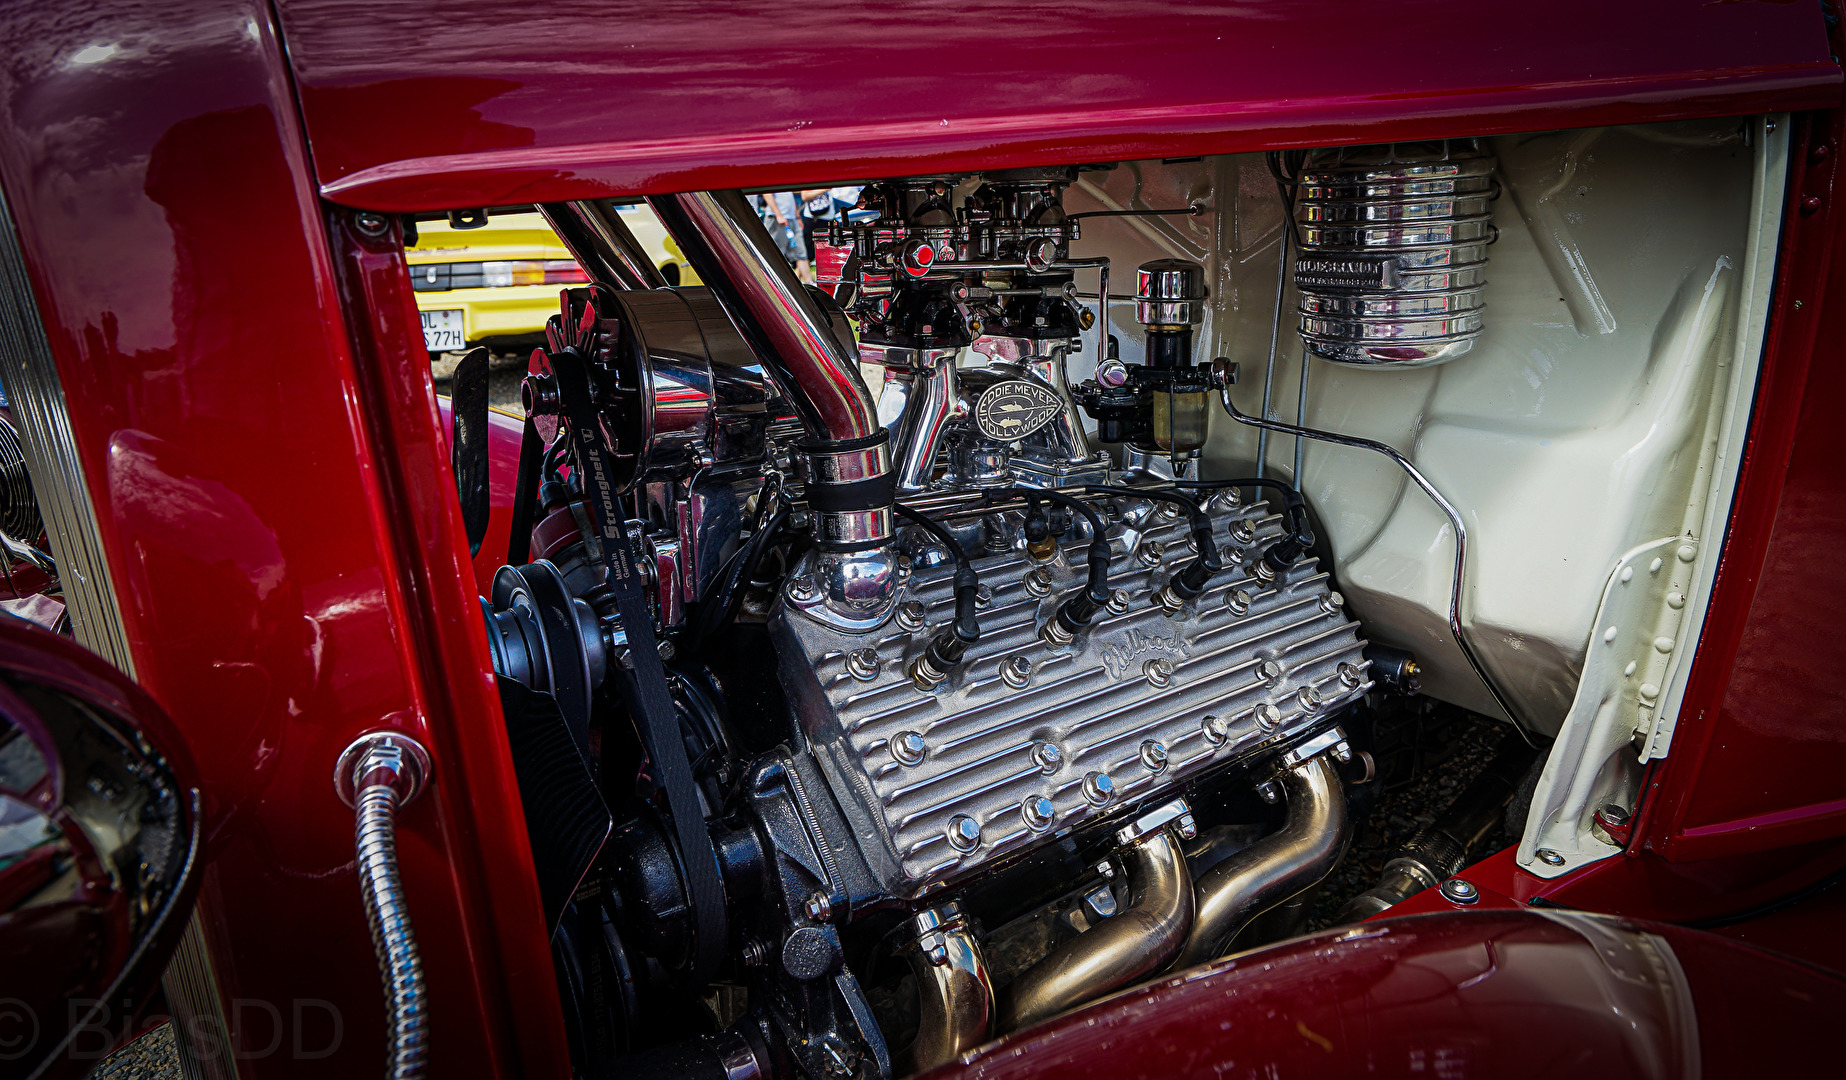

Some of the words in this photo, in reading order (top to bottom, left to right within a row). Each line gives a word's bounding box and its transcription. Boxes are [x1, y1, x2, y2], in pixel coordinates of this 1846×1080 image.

[434, 331, 461, 346] 77H
[980, 385, 1012, 416] EDDIE
[1014, 385, 1057, 405] MEYER
[980, 407, 1056, 436] HOLLYWOOD
[589, 448, 621, 539] Strongbelt
[614, 561, 623, 580] Made
[619, 548, 631, 579] Germany
[1101, 628, 1190, 680] Edelbrock
